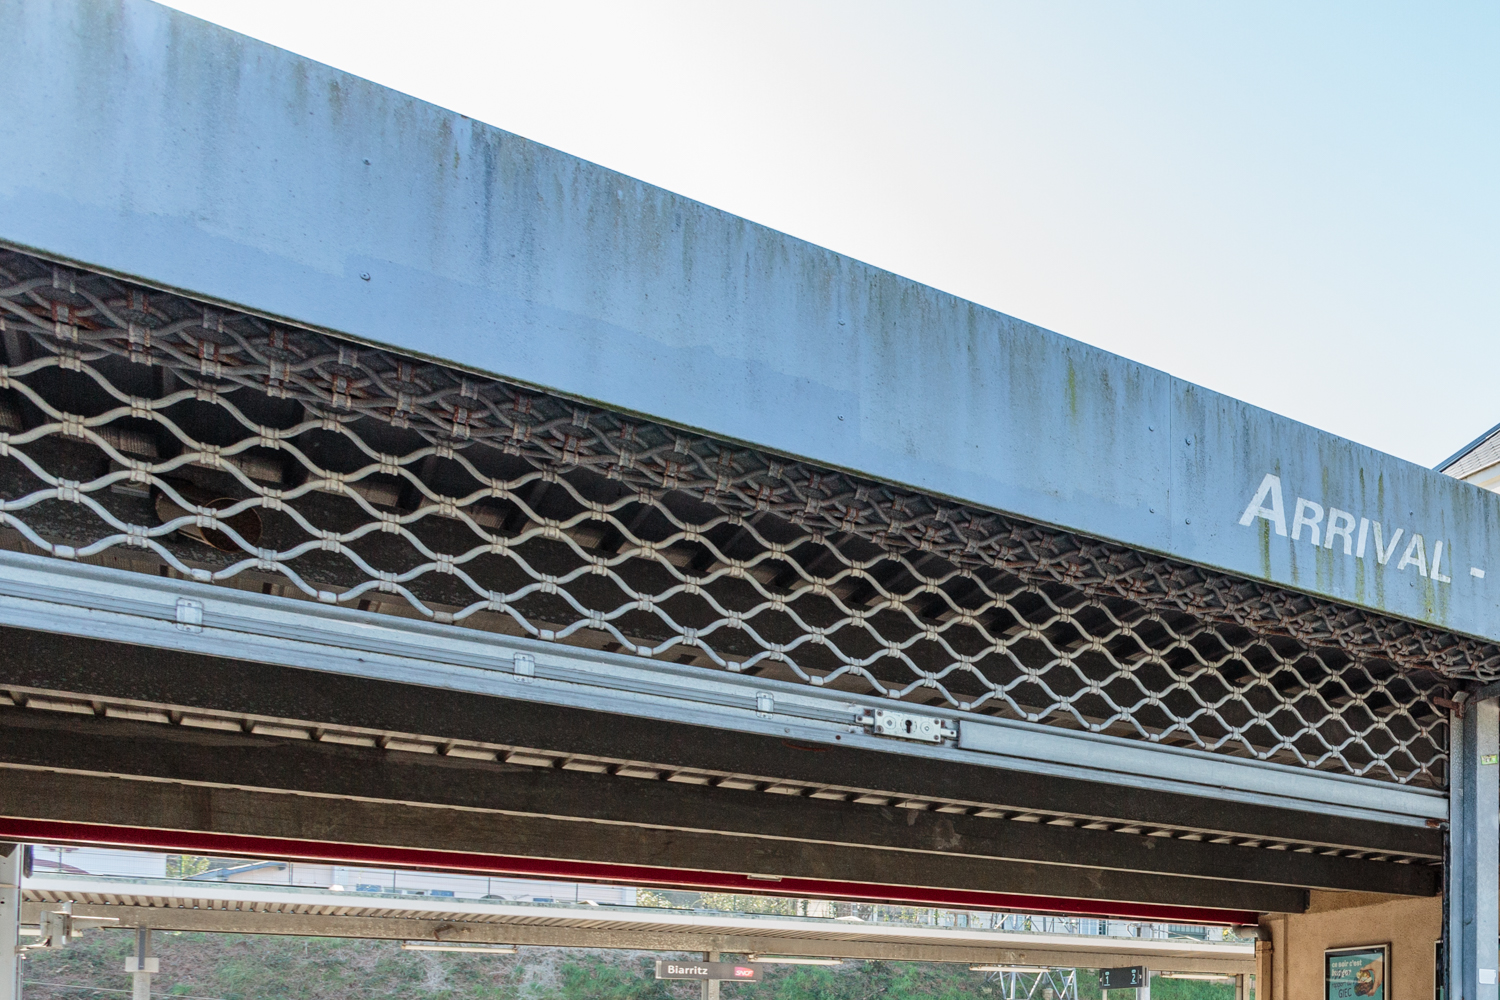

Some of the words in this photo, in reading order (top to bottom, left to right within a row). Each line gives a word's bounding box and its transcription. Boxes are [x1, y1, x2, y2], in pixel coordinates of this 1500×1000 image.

[667, 965, 708, 975] Biarritz
[1132, 973, 1136, 982] 2
[1338, 988, 1352, 998] GIEC
